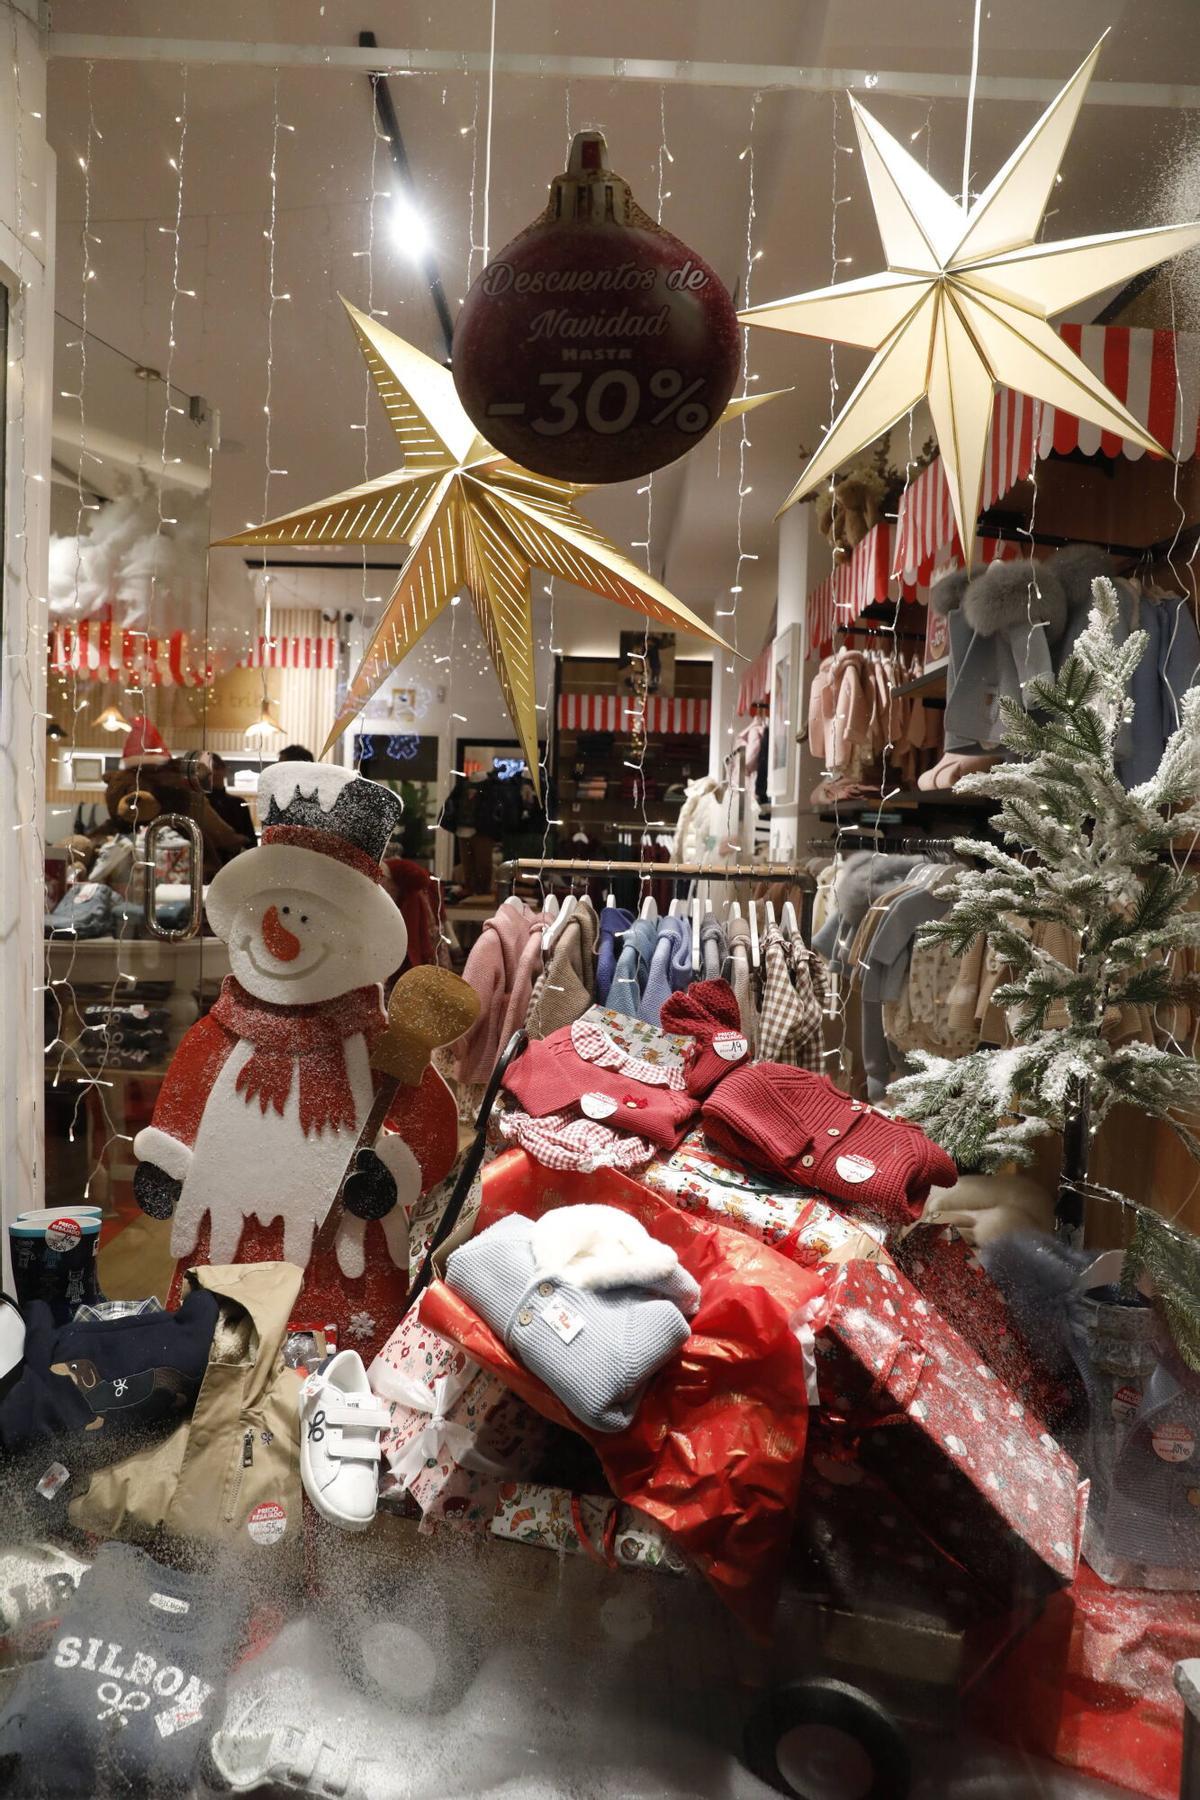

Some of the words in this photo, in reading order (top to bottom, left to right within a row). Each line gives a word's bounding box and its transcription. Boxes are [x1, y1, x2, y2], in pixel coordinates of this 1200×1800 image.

[482, 261, 656, 296] Descuentos
[667, 261, 711, 291] de
[526, 304, 671, 342] Navidad
[561, 349, 633, 361] HASTA
[58, 1220, 78, 1230] PRECIO
[252, 1511, 284, 1521] REBAJADO
[257, 1506, 279, 1515] PRECIO
[54, 1636, 215, 1703] SILBON
